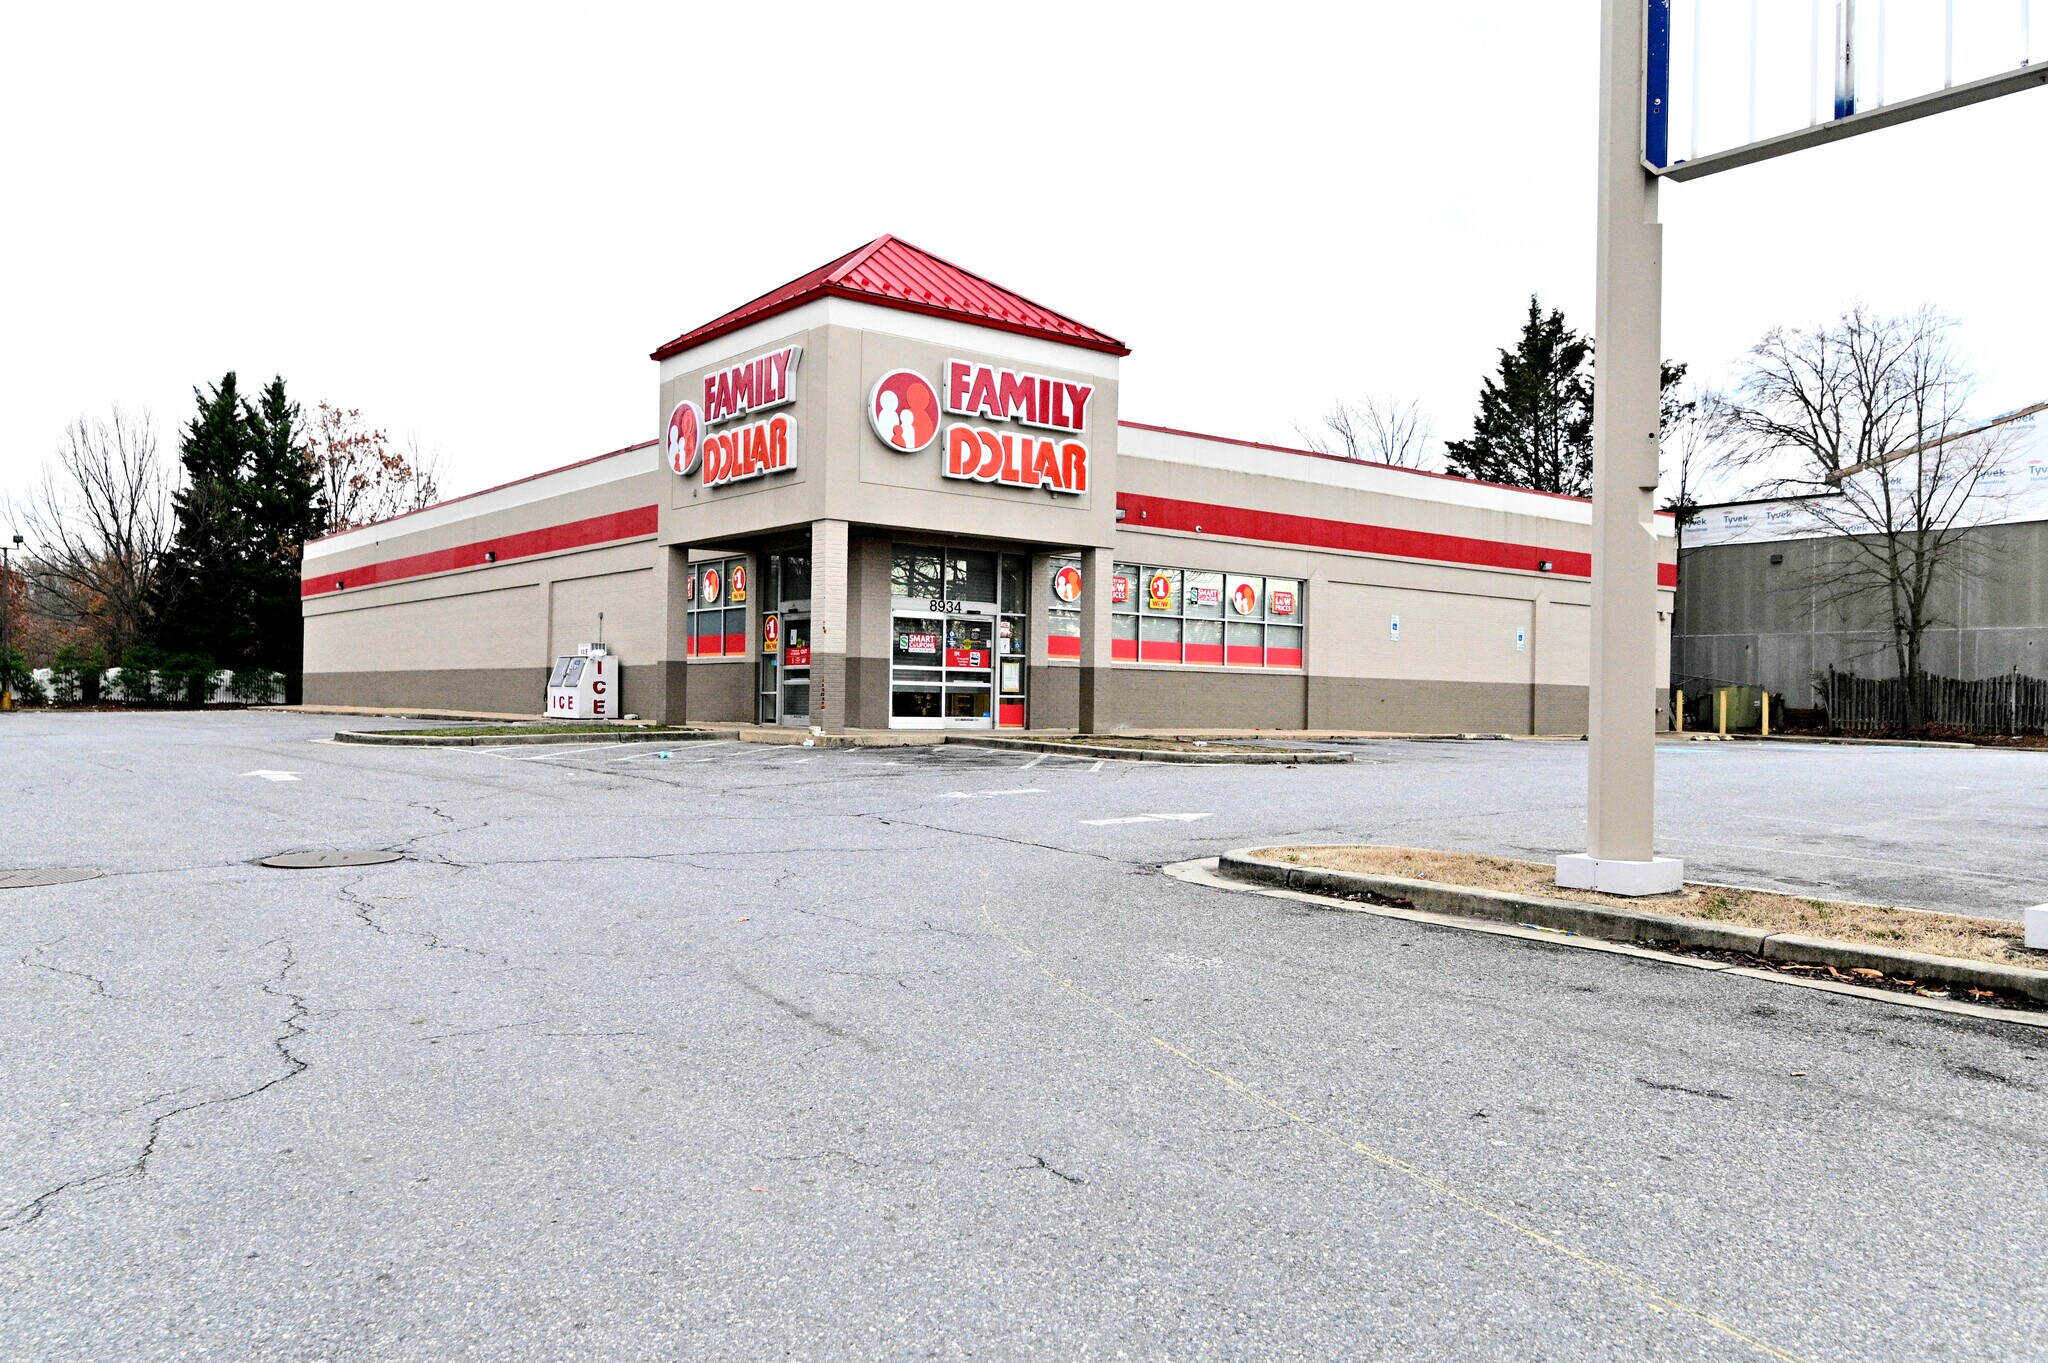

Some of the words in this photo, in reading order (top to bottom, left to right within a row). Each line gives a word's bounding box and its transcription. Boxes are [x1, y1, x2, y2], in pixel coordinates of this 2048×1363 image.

[704, 348, 791, 422] FAMILY
[950, 362, 1092, 430] FAMILY
[703, 417, 788, 484] DOLLAR
[949, 427, 1087, 491] DOLLAR
[1980, 468, 2006, 480] yvek
[1724, 515, 1749, 525] Tyvek
[1766, 510, 1791, 520] Tyvek
[929, 599, 962, 613] 8934
[909, 634, 935, 643] SMART
[592, 660, 606, 714] ICE
[553, 695, 573, 710] ICE
